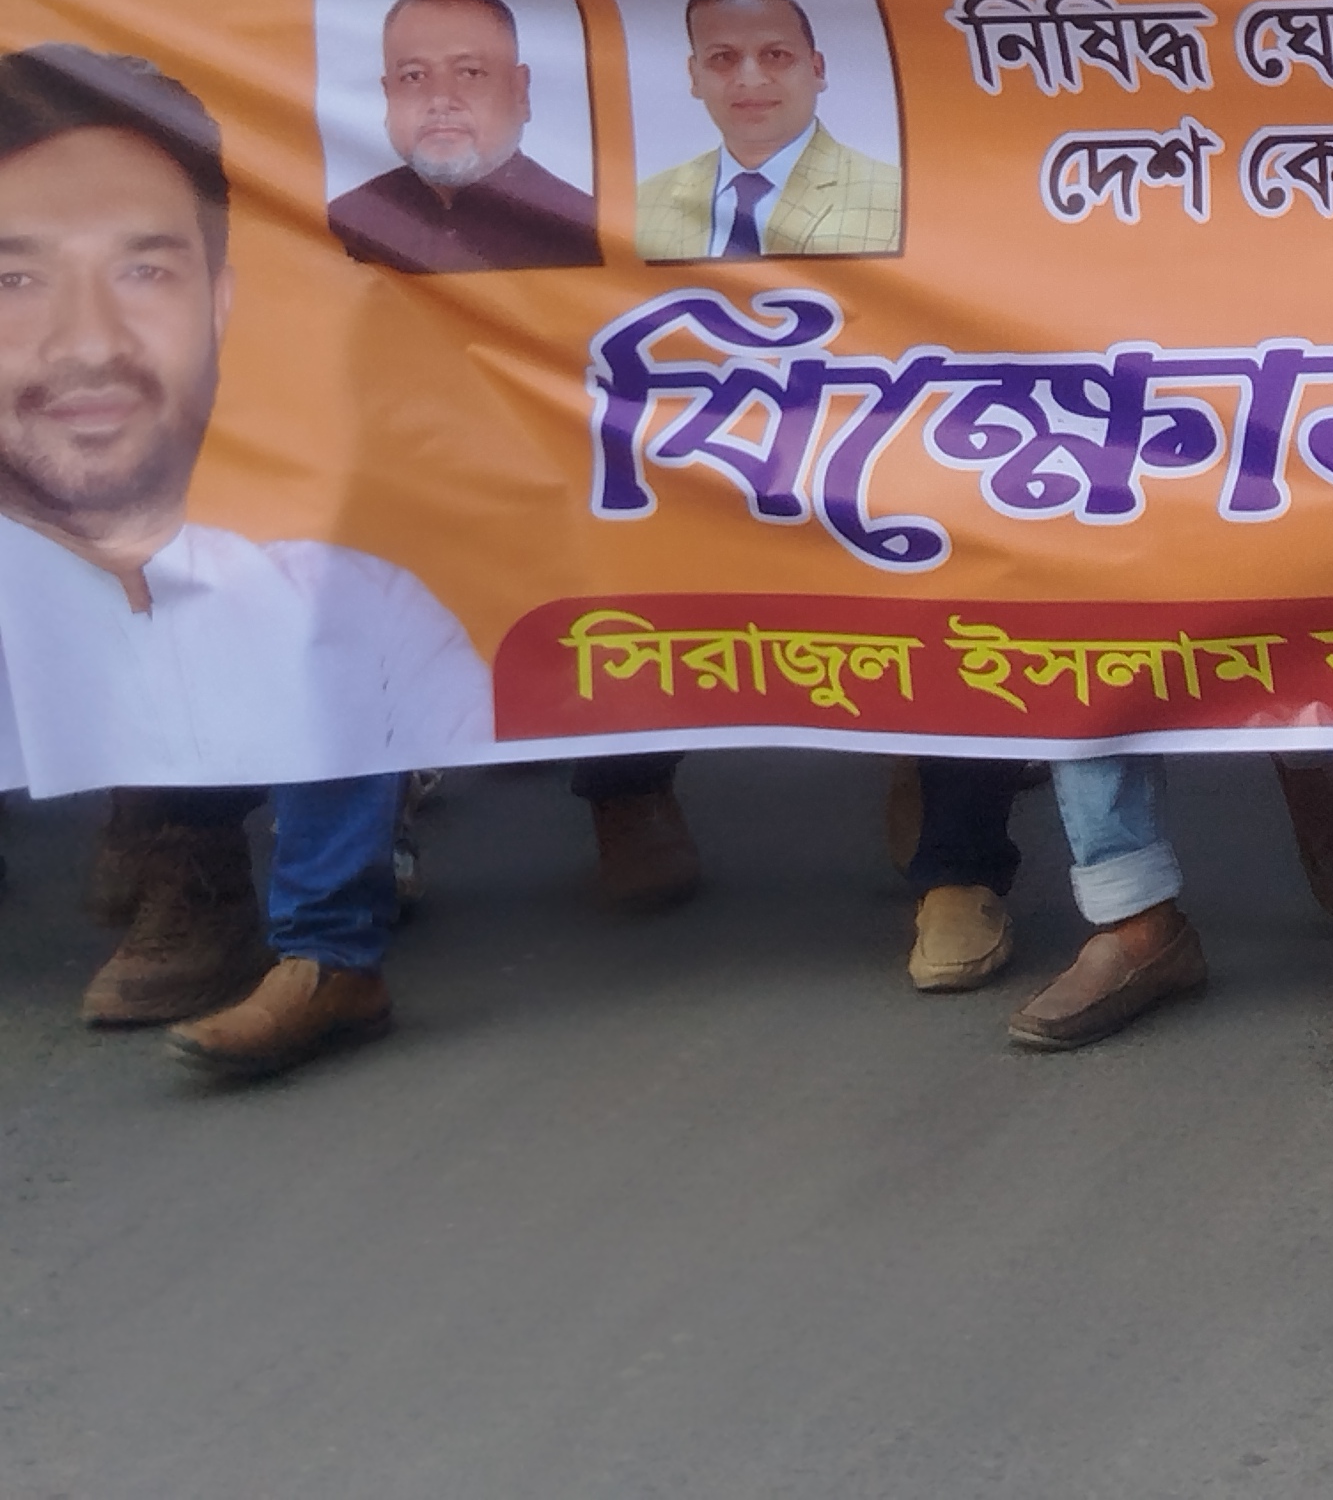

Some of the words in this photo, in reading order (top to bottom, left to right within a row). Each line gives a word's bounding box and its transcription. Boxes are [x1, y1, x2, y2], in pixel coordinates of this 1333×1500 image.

[1043, 118, 1222, 222] দেশ
[558, 609, 924, 717] সিরাজুল
[944, 613, 1288, 713] ইসলাম
